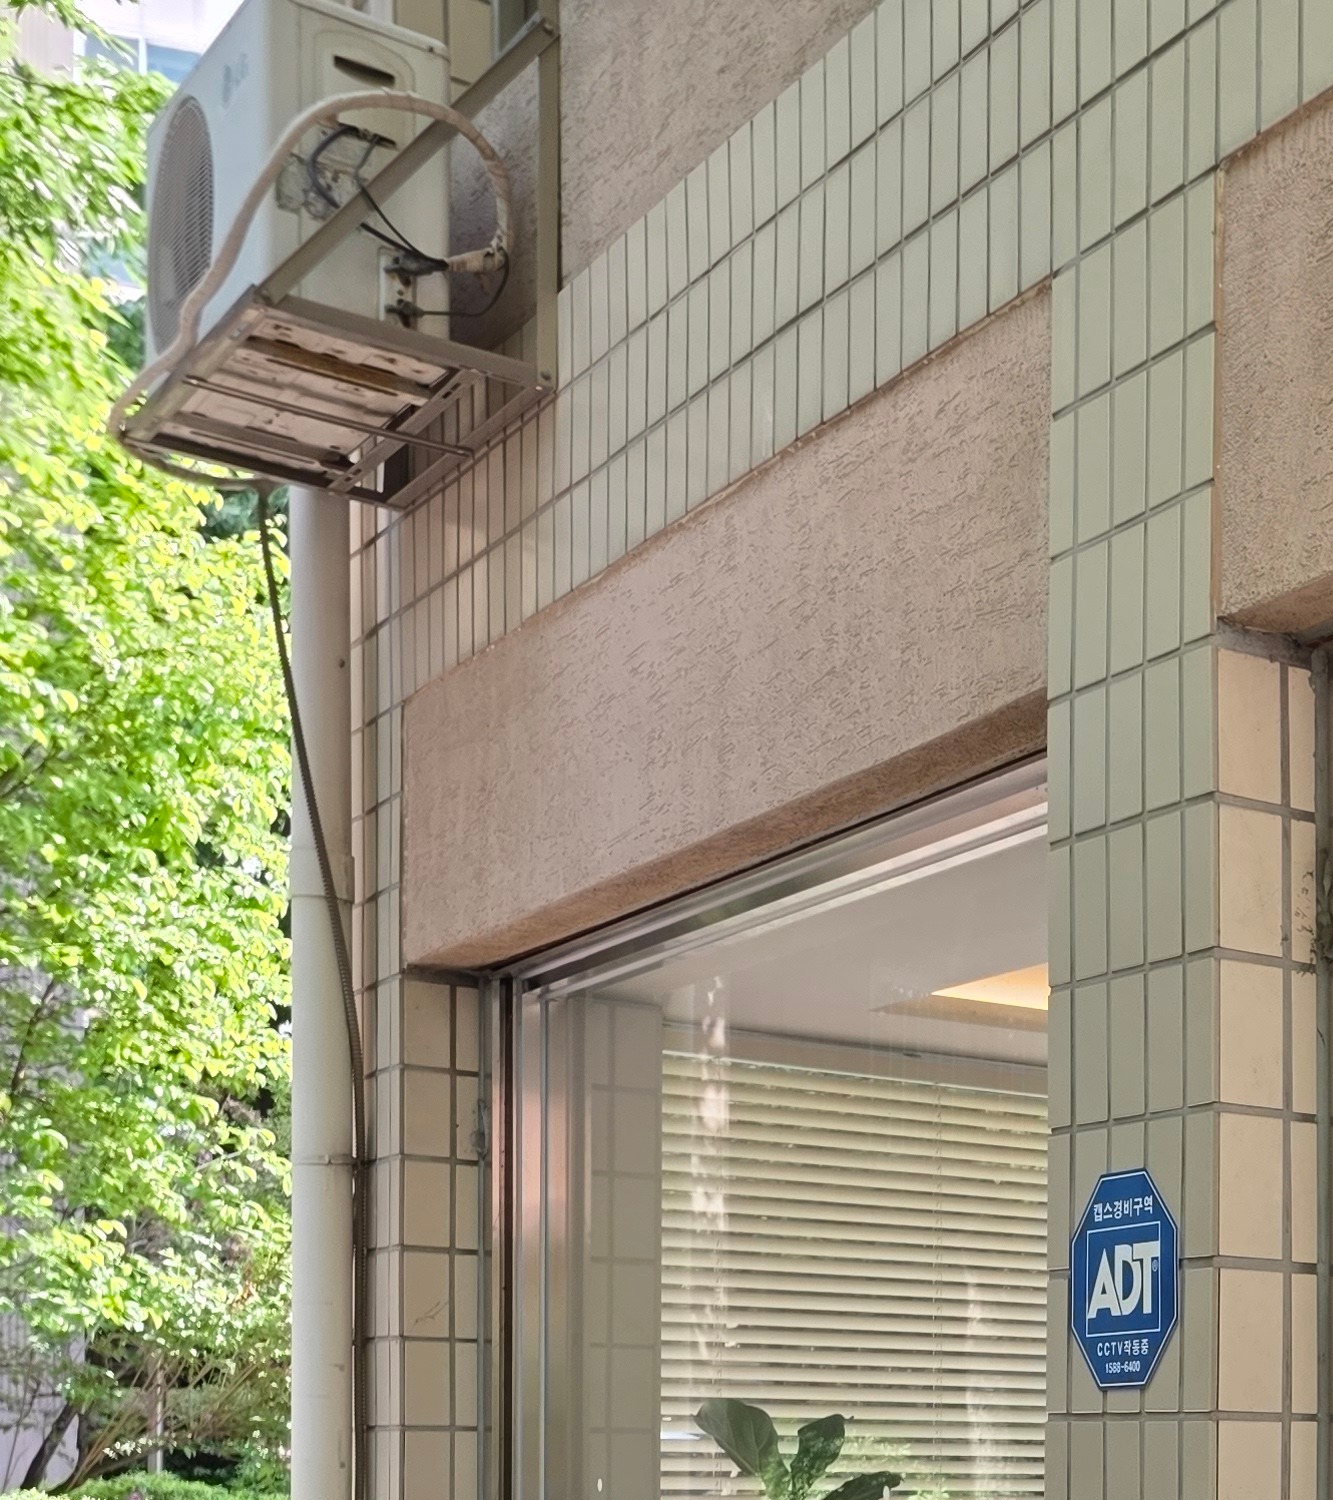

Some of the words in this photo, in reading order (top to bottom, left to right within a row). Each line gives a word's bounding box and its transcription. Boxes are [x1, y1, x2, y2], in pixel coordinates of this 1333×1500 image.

[1093, 1195, 1153, 1222] 캡스경비구역
[1087, 1240, 1160, 1320] ADT
[1097, 1338, 1149, 1357] CCTV작동중
[1105, 1360, 1141, 1374] 1588-6400
